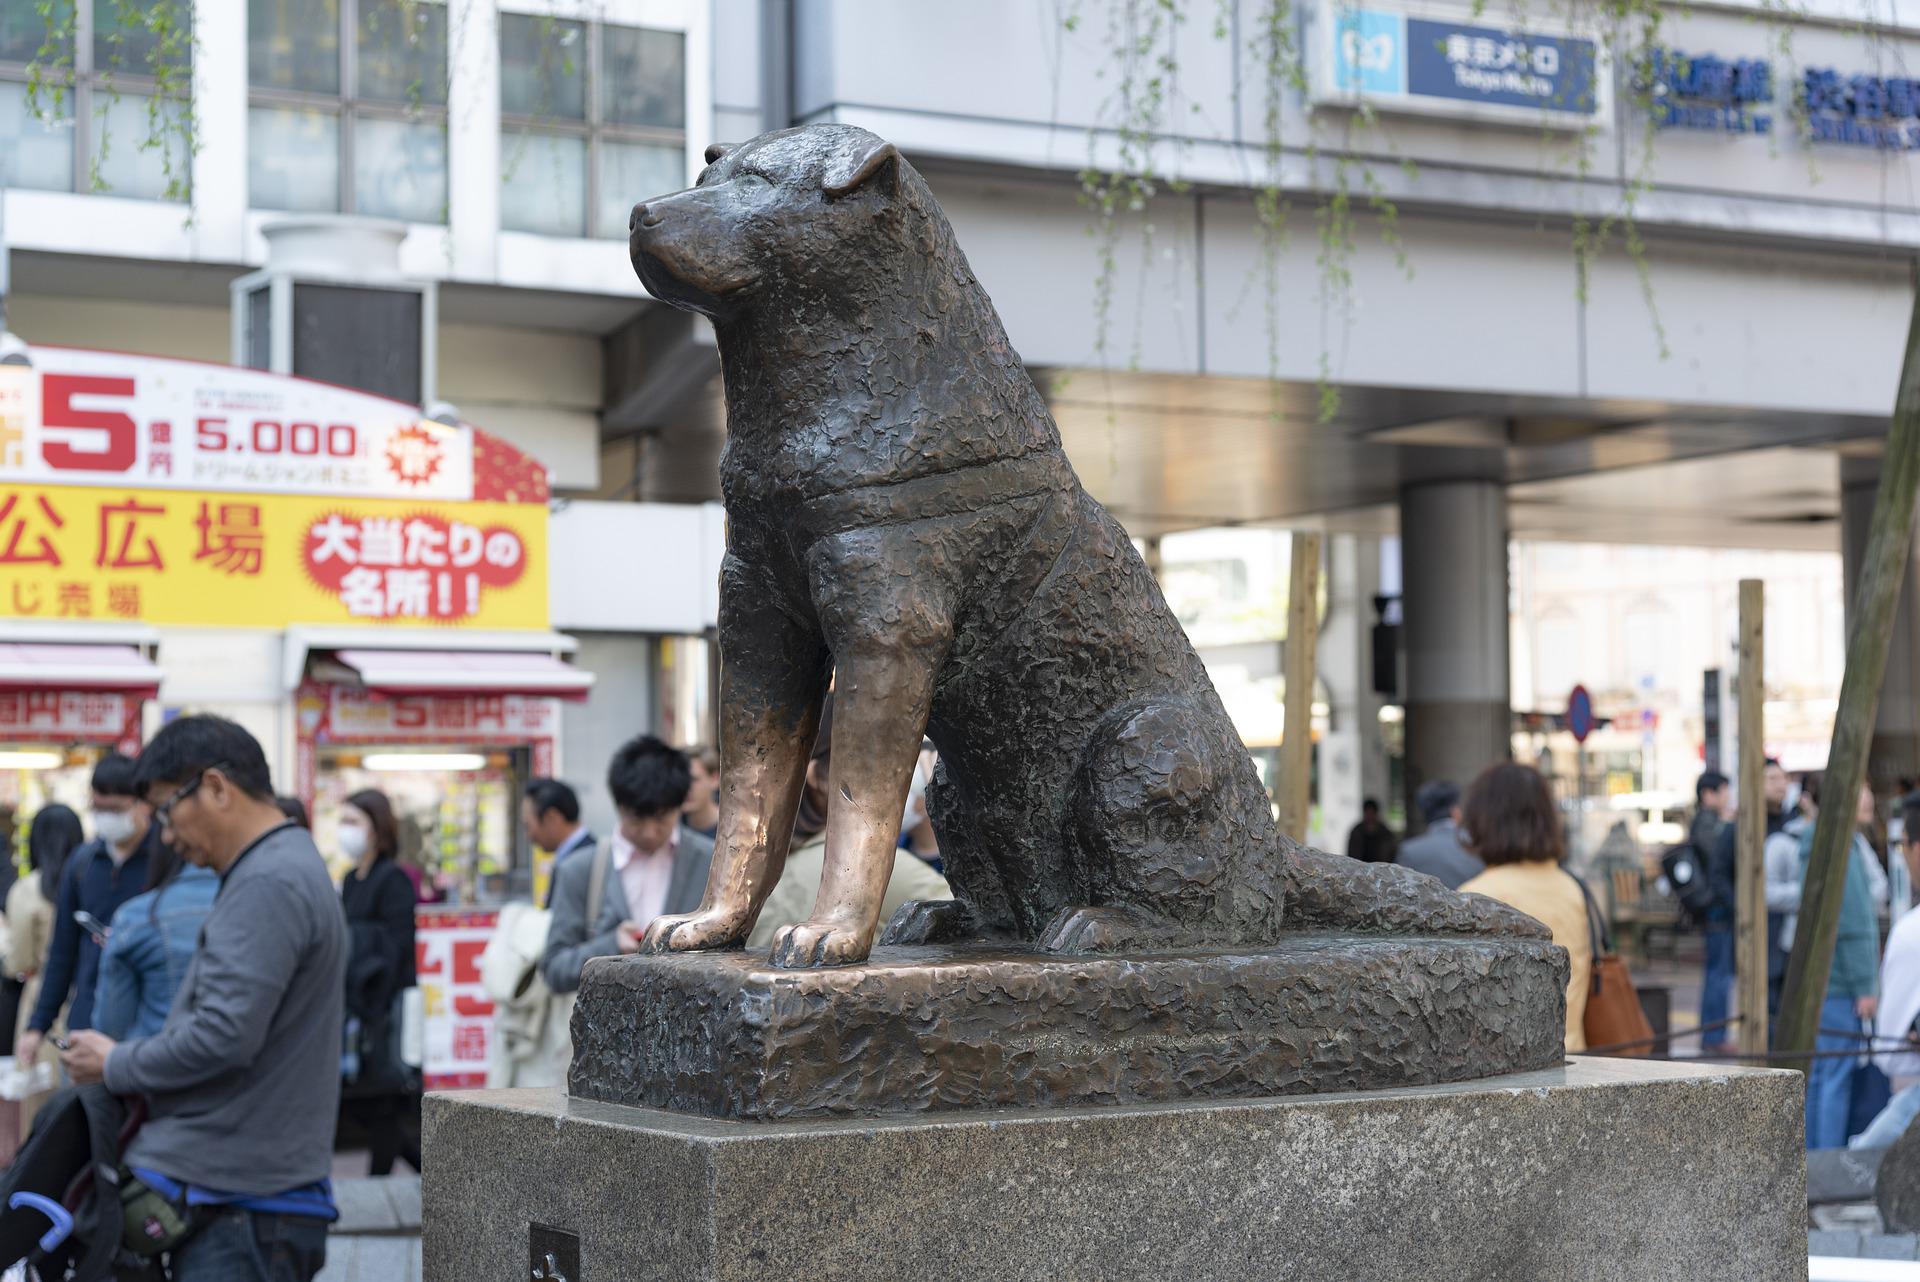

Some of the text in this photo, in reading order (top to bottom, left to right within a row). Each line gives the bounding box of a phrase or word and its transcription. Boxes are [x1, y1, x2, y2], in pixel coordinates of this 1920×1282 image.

[42, 373, 136, 472] 5
[0, 494, 264, 575] 公広場
[311, 514, 521, 567] 大当たりの
